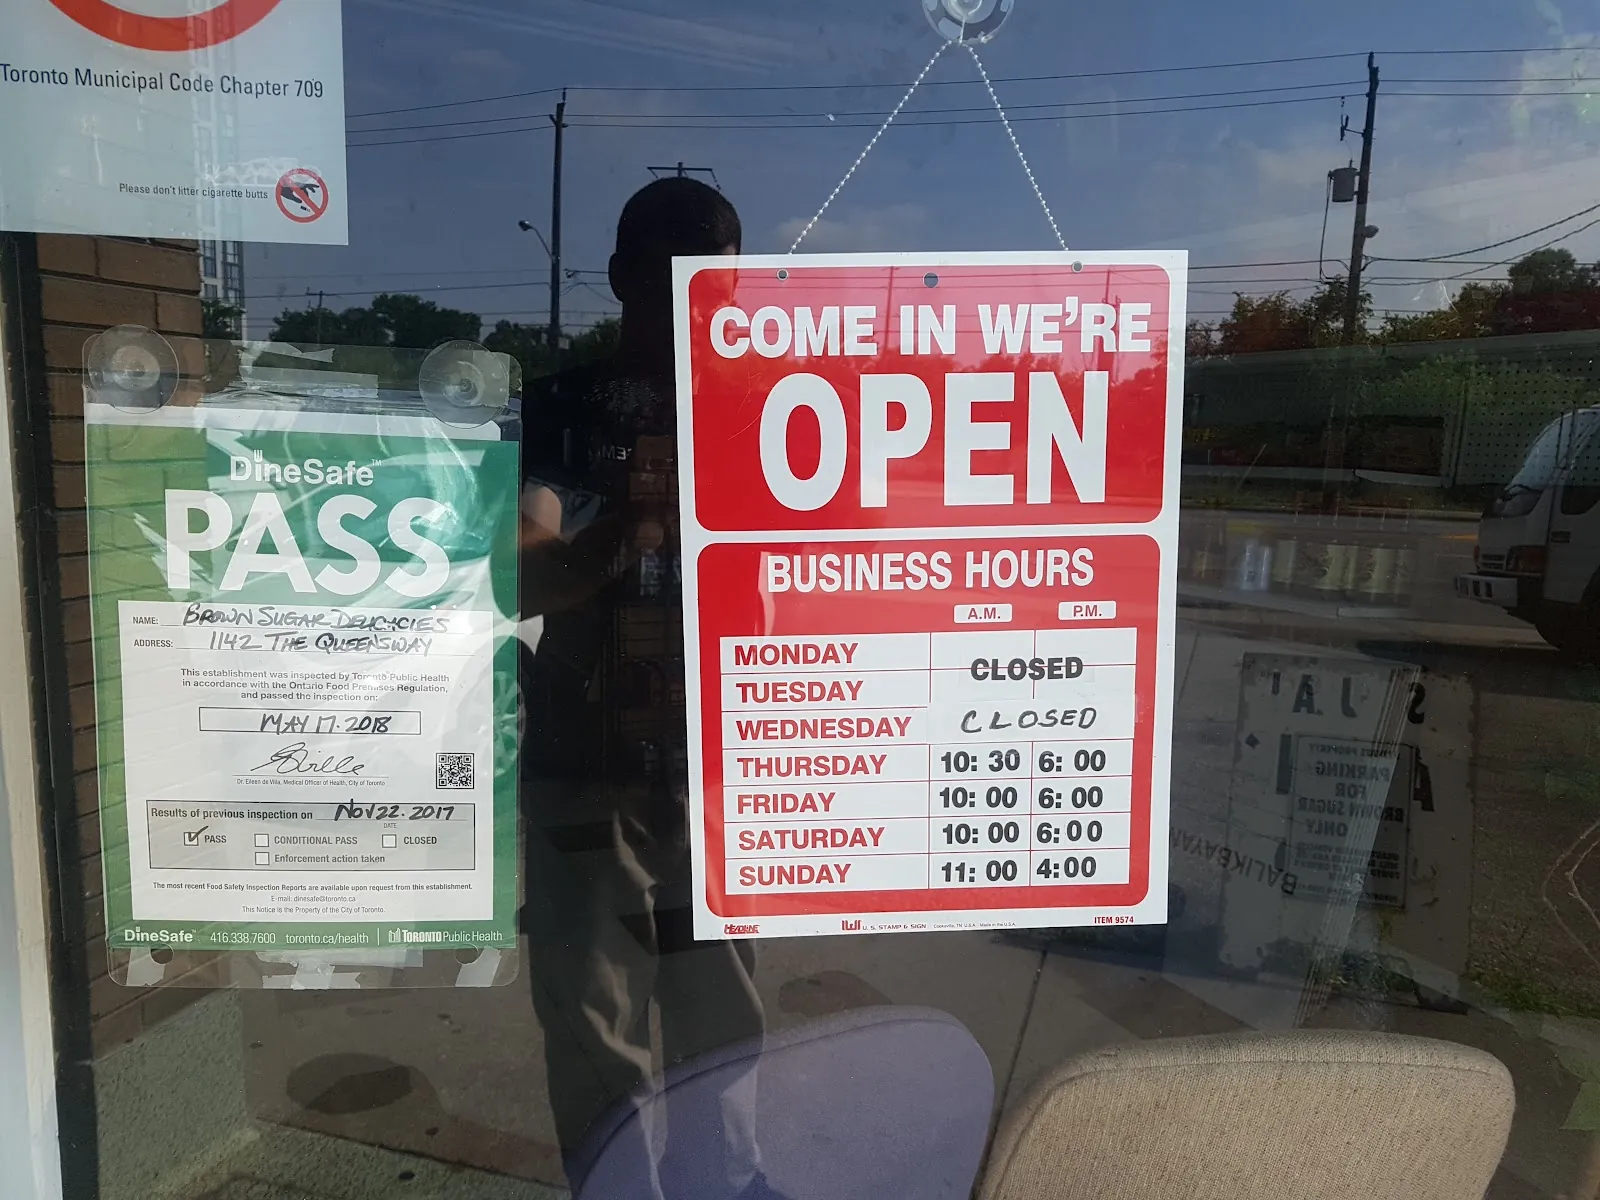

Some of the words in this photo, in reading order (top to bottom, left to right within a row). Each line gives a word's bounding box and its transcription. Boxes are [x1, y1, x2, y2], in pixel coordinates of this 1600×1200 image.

[0, 64, 68, 85] Toronto
[75, 68, 163, 92] Municipal
[170, 73, 213, 92] Code
[221, 75, 289, 98] Chapter
[295, 80, 323, 97] 709
[119, 183, 150, 193] Please
[153, 185, 176, 195] don't
[178, 186, 199, 196] litter
[202, 188, 243, 199] cigarette
[245, 188, 268, 199] butts
[710, 305, 877, 358] COME
[900, 304, 956, 355] IN
[978, 296, 1151, 354] WE'RE
[759, 370, 1109, 510] OPEN
[230, 450, 374, 486] DineSafe
[165, 489, 450, 597] PASS
[768, 550, 952, 592] BUSINESS
[965, 548, 1094, 588] HOURS
[967, 607, 1001, 620] A.M.
[1073, 604, 1102, 617] P.M.
[132, 616, 159, 625] NAME:
[134, 639, 173, 648] ADDRESS:
[210, 631, 263, 650] 1142
[264, 631, 308, 652] THE
[734, 643, 858, 666] MONDAY
[181, 668, 200, 676] This
[202, 669, 267, 678] establishment
[291, 671, 336, 680] inspected
[338, 672, 350, 681] by
[389, 673, 418, 681] Public
[421, 674, 450, 682] Health
[971, 656, 1083, 680] CLOSED
[182, 679, 191, 687] in
[193, 680, 247, 688] accordance
[272, 681, 287, 689] the
[289, 682, 323, 690] Ontario
[326, 682, 349, 690] Food
[397, 684, 448, 693] Regulation,
[736, 680, 863, 703] TUESDAY
[260, 692, 294, 700] passed
[296, 692, 311, 700] the
[313, 693, 361, 701] inspection
[260, 713, 309, 735] MAY
[961, 707, 1097, 733] CLOSED
[737, 716, 911, 741] WEDNESDAY
[737, 754, 887, 777] THURSDAY
[737, 792, 835, 814] FRIDAY
[151, 808, 187, 818] Results
[190, 809, 200, 818] of
[203, 809, 244, 819] previous
[248, 810, 299, 820] inspection
[301, 811, 312, 819] on
[204, 835, 227, 843] PASS
[274, 836, 332, 845] CONDITIONAL
[335, 837, 358, 845] PASS
[403, 836, 437, 845] CLOSED
[738, 827, 885, 851] SATURDAY
[274, 854, 329, 863] Enforcement
[332, 854, 358, 863] action
[361, 854, 385, 863] taken
[739, 863, 851, 886] SUNDAY
[1036, 856, 1096, 879] 4:00
[224, 883, 244, 891] Safety
[246, 883, 280, 891] Inspection
[281, 884, 307, 892] Reports
[369, 884, 394, 892] request
[295, 906, 320, 915] Property
[340, 907, 352, 915] City
[1094, 916, 1112, 924] ITEM
[1115, 916, 1134, 924] 9574
[124, 926, 193, 943] DineSafe
[402, 930, 442, 943] TORONTO
[443, 931, 470, 942] Public
[472, 930, 503, 942] Health
[724, 924, 760, 934] HEADLINE
[210, 932, 276, 944] 416.338.7600
[285, 932, 368, 944] toronto.ca/health
